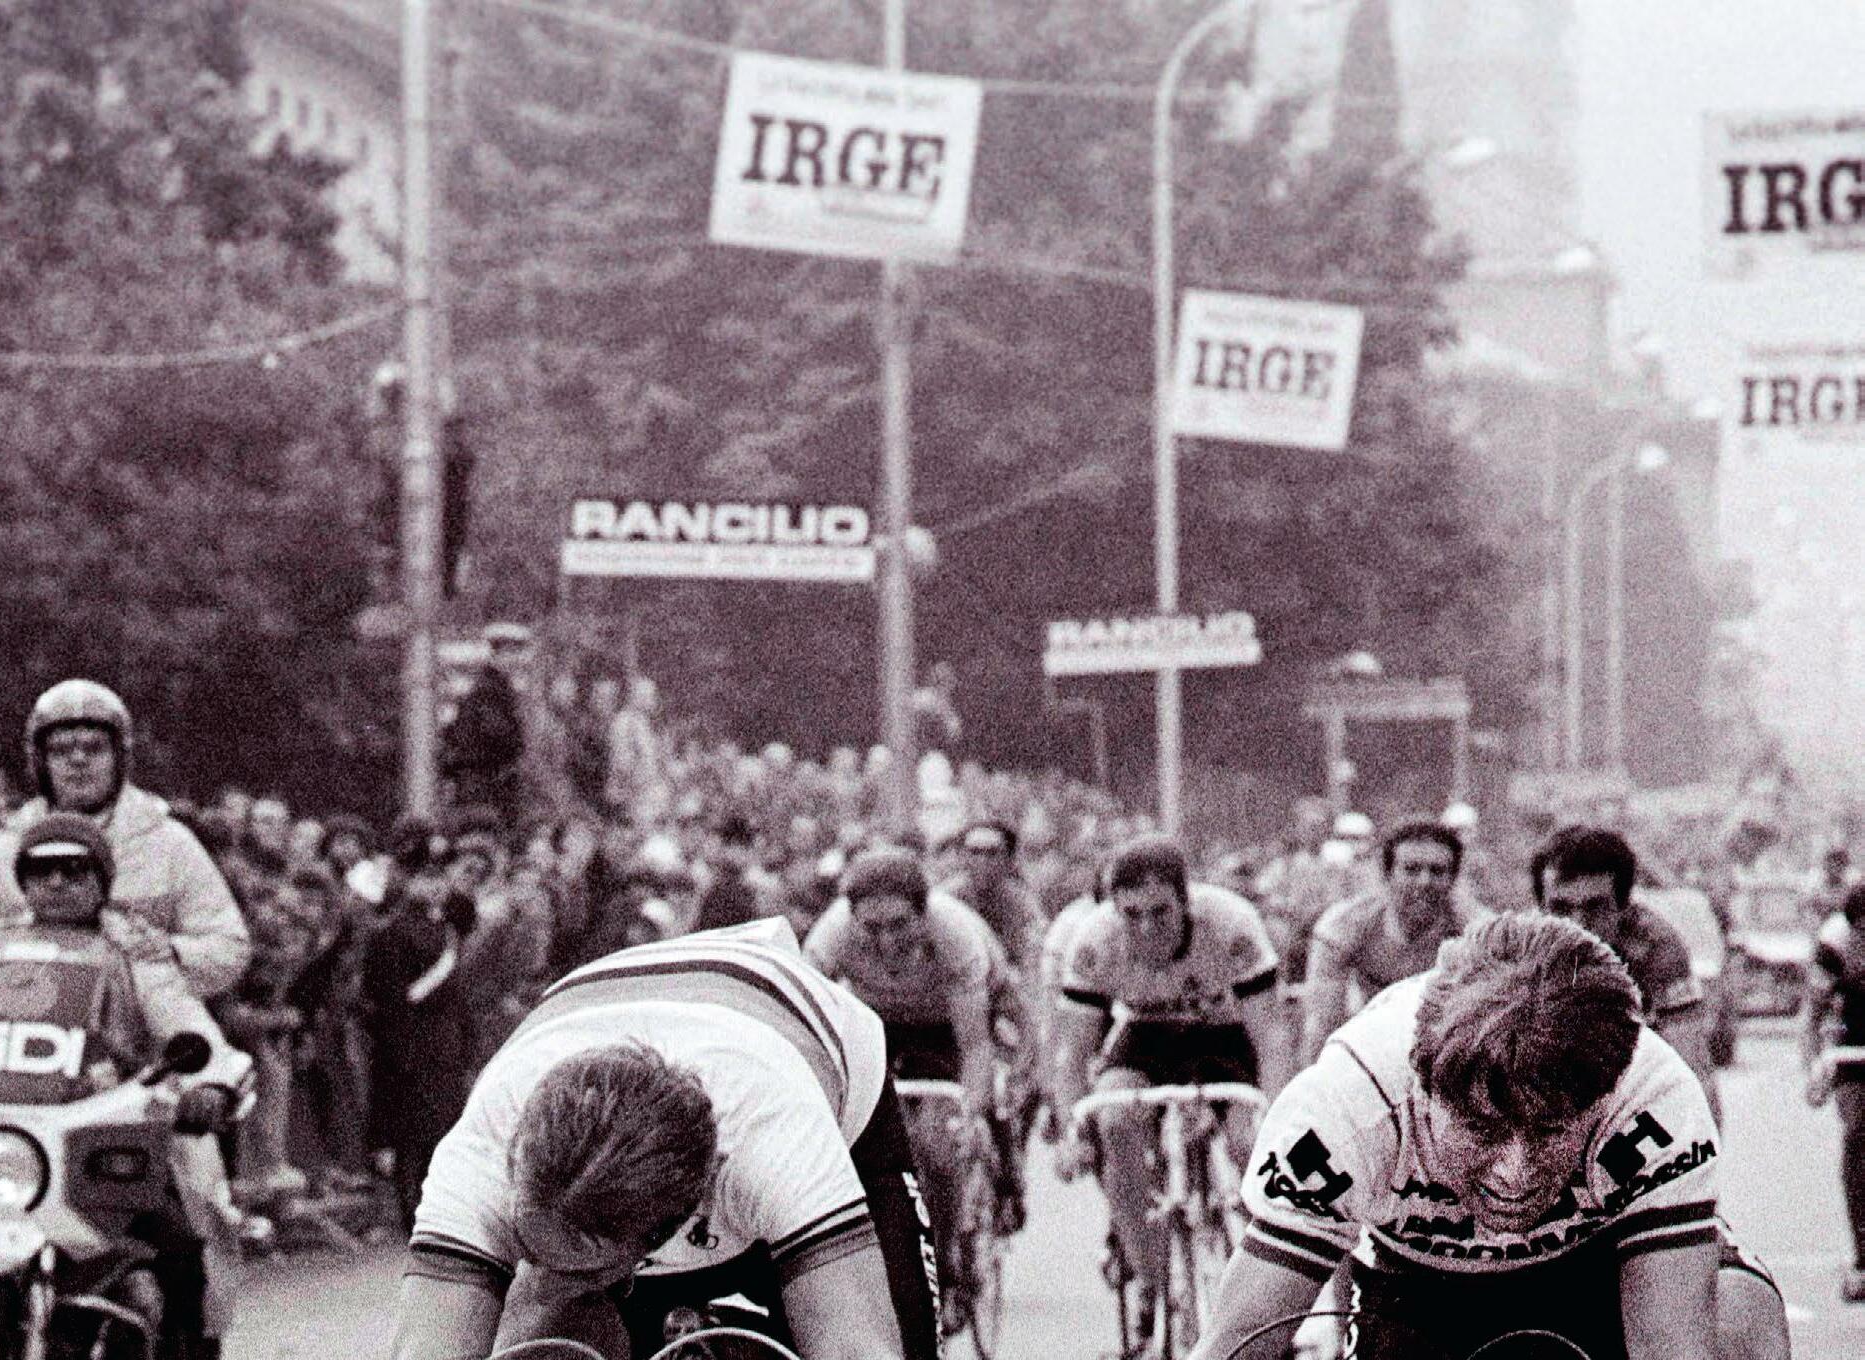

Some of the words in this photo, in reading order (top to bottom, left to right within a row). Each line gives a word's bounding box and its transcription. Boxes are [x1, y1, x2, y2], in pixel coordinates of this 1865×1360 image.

[741, 113, 945, 201] IRGE
[1192, 337, 1336, 399] IRGE
[573, 499, 869, 544] RANCILIO
